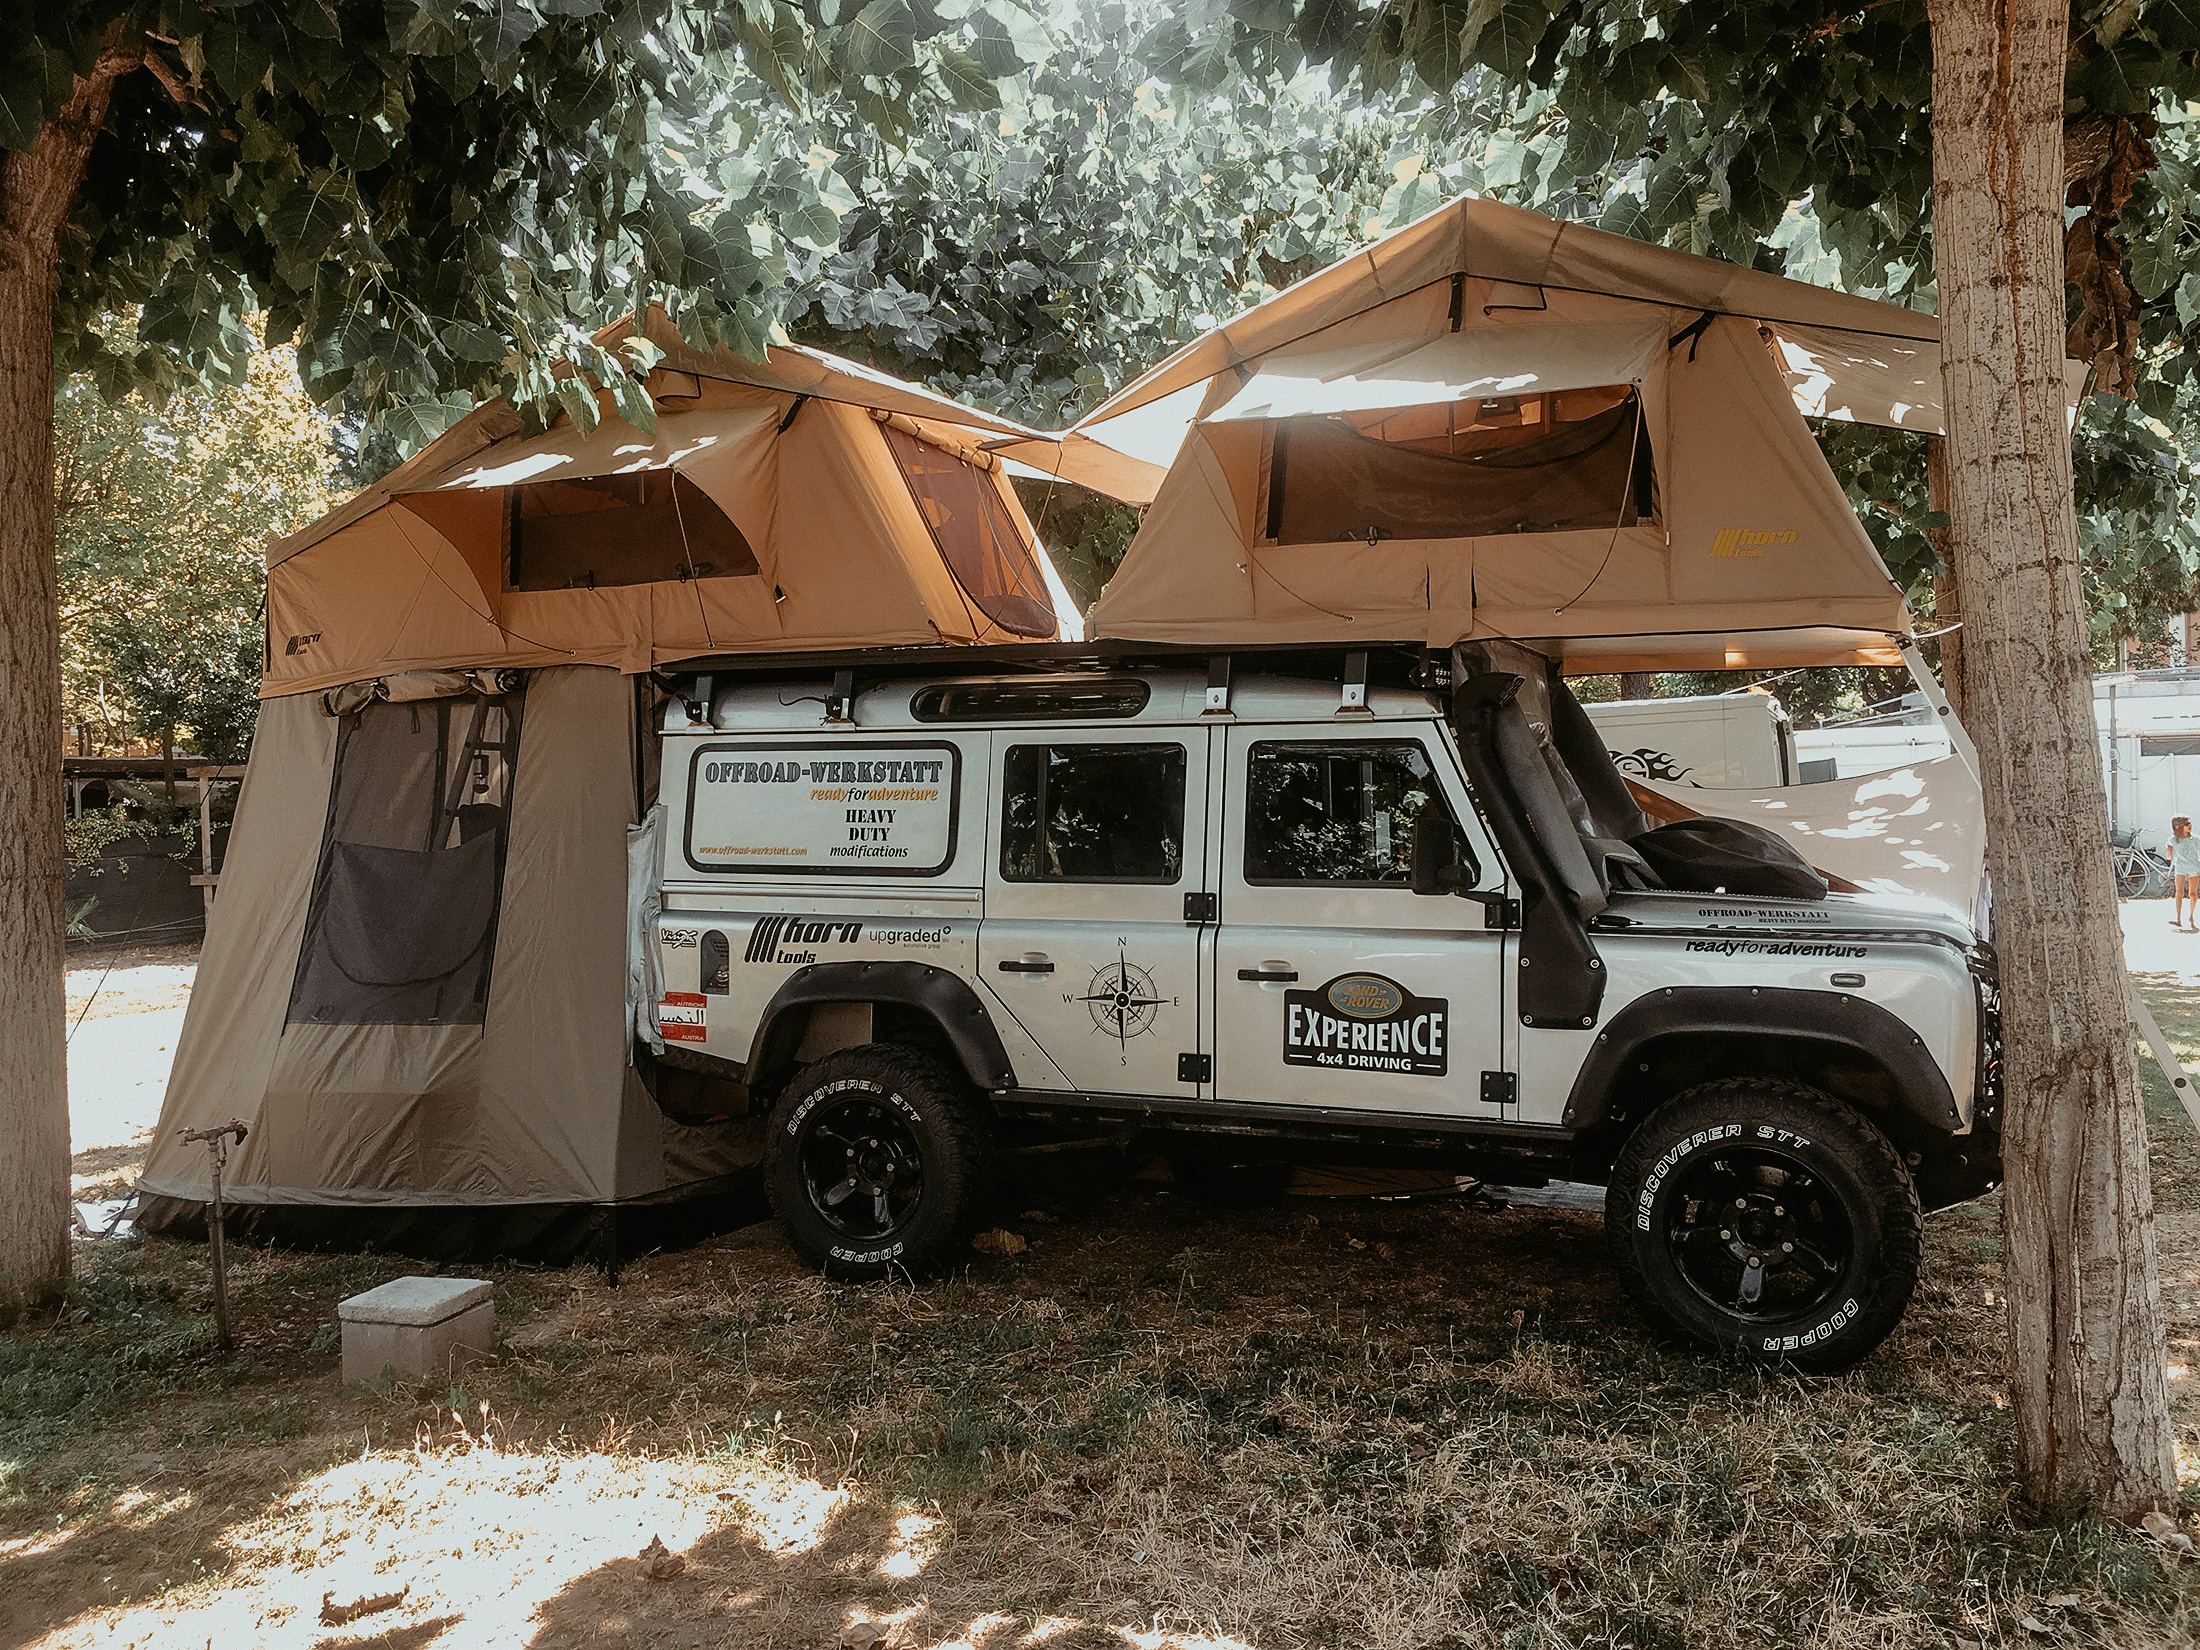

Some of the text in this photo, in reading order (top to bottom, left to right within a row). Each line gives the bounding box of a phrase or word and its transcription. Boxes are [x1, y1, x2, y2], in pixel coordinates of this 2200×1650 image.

[1739, 528, 1797, 545] horn
[705, 761, 943, 783] OFFROAD-WERKSTATT
[810, 787, 938, 802] readyforadventure
[845, 809, 897, 824] HEAVY
[848, 827, 890, 842] DUTY
[699, 846, 808, 856] www.offroad-werkstatt.com
[829, 844, 908, 858] modifications
[1698, 909, 1829, 918] OFFROAD-WERKSTATT
[783, 917, 863, 943] horn
[869, 928, 941, 945] upgraded
[1117, 937, 1127, 946] N
[1685, 940, 1868, 958] readyforadventure
[776, 950, 816, 964] tools
[1345, 984, 1379, 996] LAND
[1062, 994, 1073, 1003] W
[1174, 997, 1180, 1007] E
[1347, 997, 1390, 1009] ROVER
[660, 1009, 703, 1025] النمس
[1288, 1004, 1443, 1056] EXPERIENCE
[1120, 1056, 1127, 1066] S
[1316, 1052, 1412, 1071] 4x4 DRIVING
[787, 1079, 921, 1135] DISCOVERER STT
[1637, 1124, 1810, 1231] DISCOVERER STT
[829, 1241, 903, 1263] COOPER
[1763, 1298, 1859, 1351] COOPER
